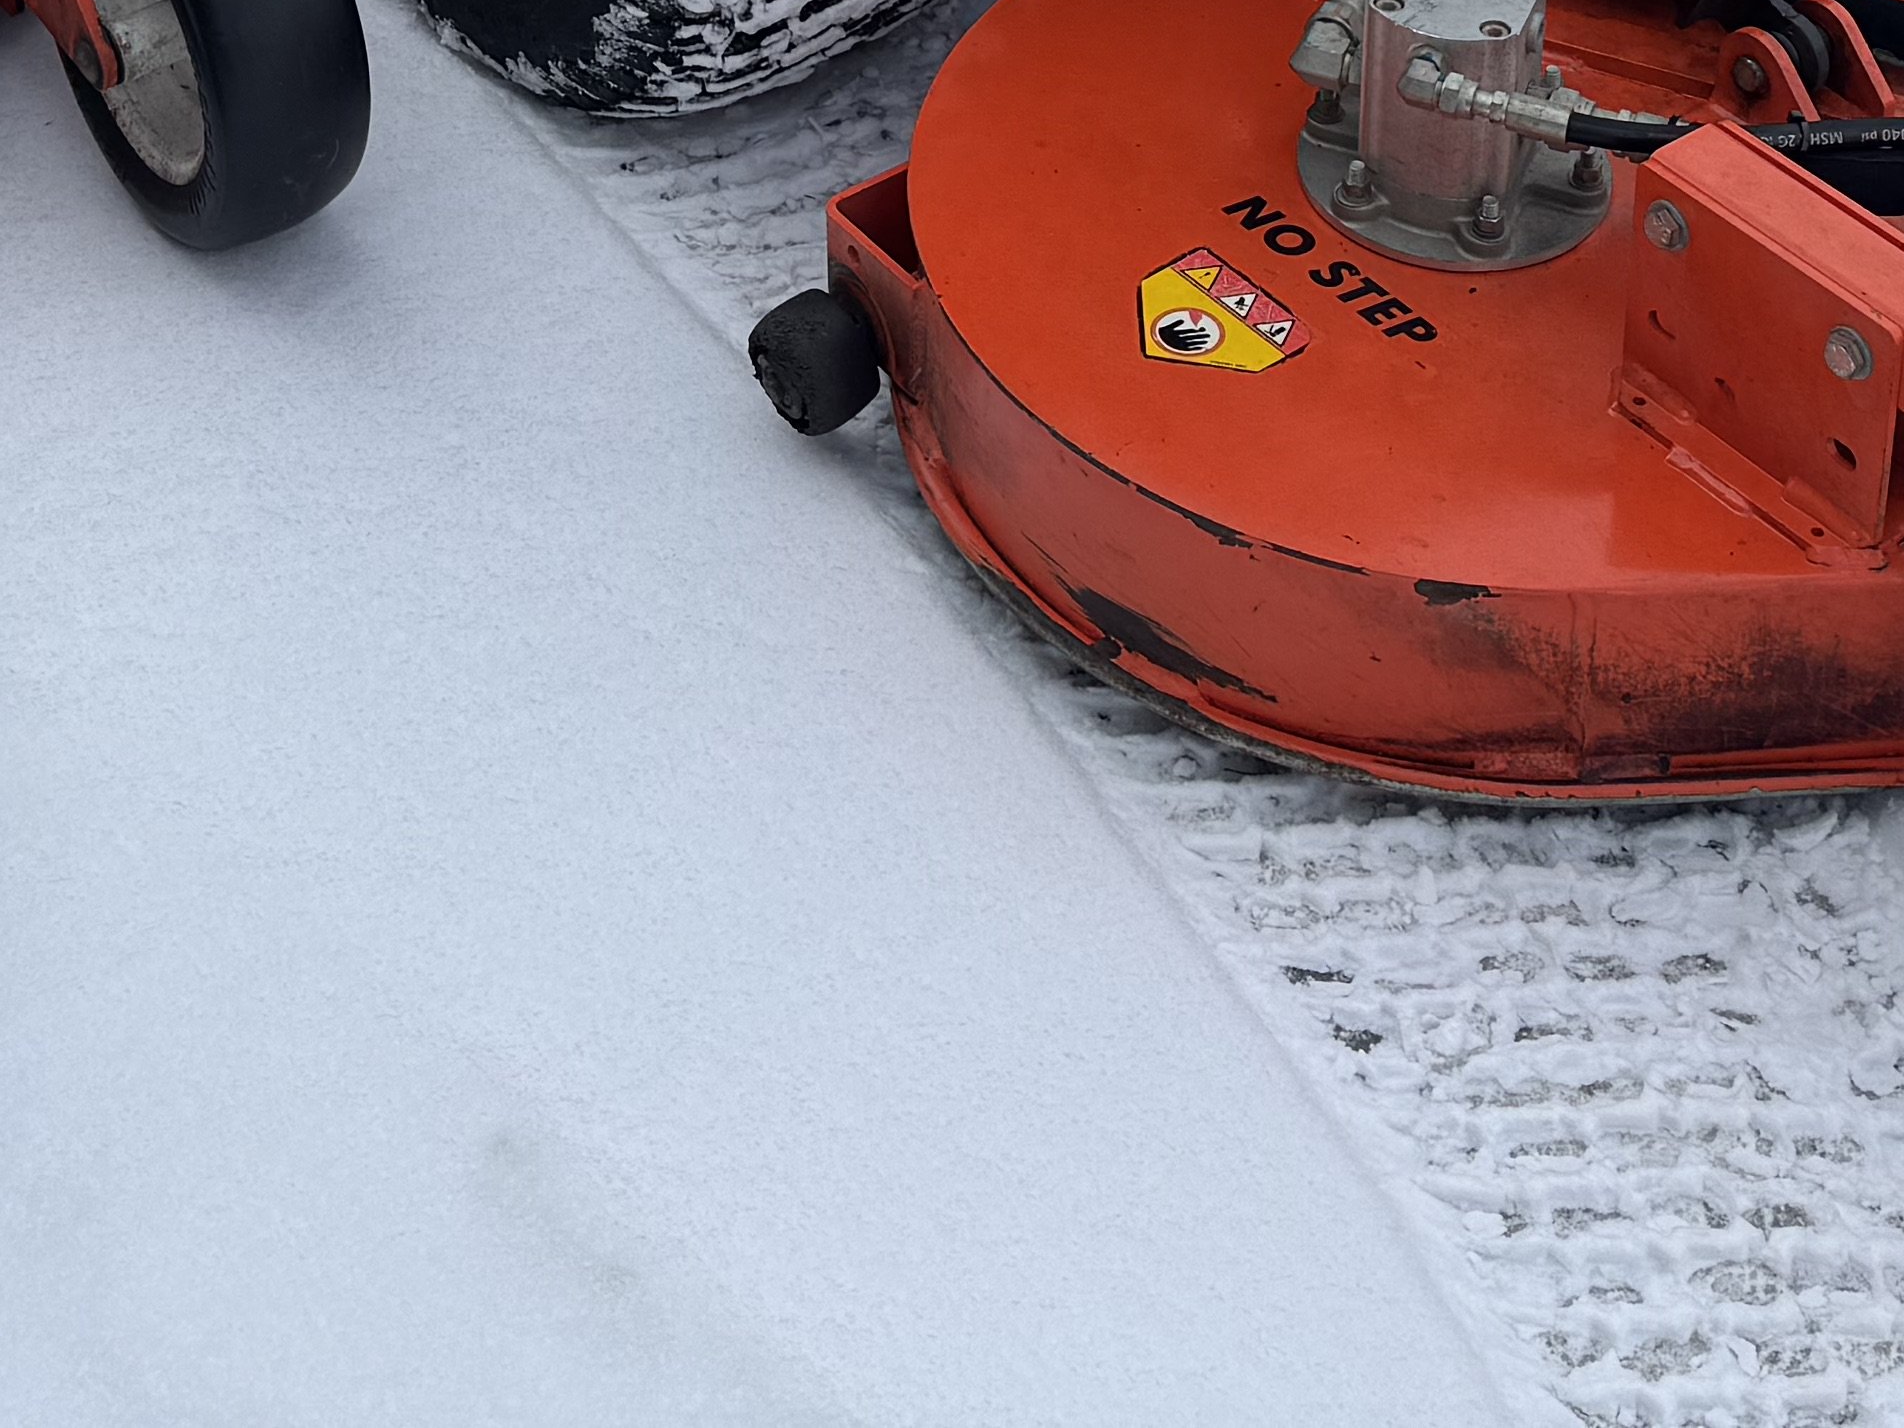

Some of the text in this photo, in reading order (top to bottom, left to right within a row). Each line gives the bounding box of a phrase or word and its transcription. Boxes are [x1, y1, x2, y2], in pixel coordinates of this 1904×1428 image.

[1801, 130, 1844, 146] MSH
[1860, 130, 1878, 142] psi
[1221, 195, 1438, 342] NO STEP
